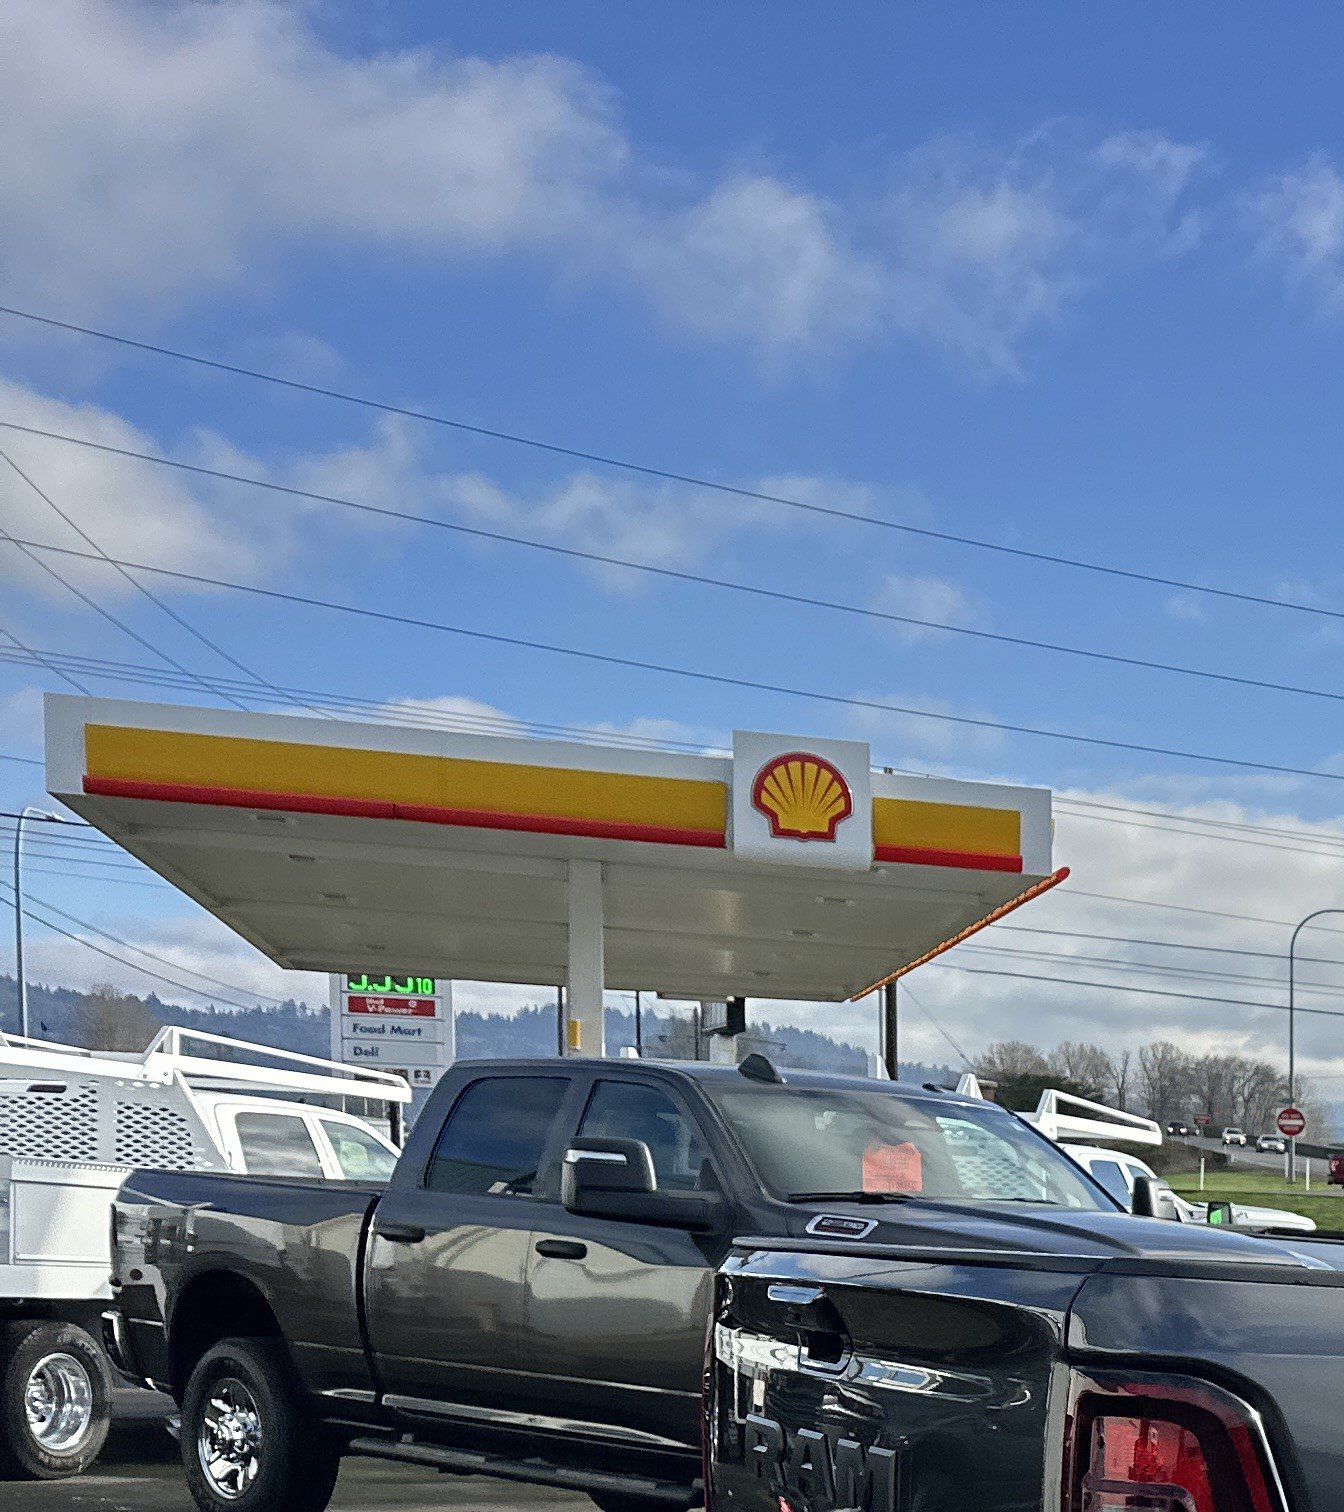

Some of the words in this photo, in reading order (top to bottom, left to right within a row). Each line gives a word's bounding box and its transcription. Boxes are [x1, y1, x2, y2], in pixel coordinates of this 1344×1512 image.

[353, 1023, 386, 1034] Food
[391, 1025, 422, 1037] Mart
[353, 1046, 380, 1057] Deli
